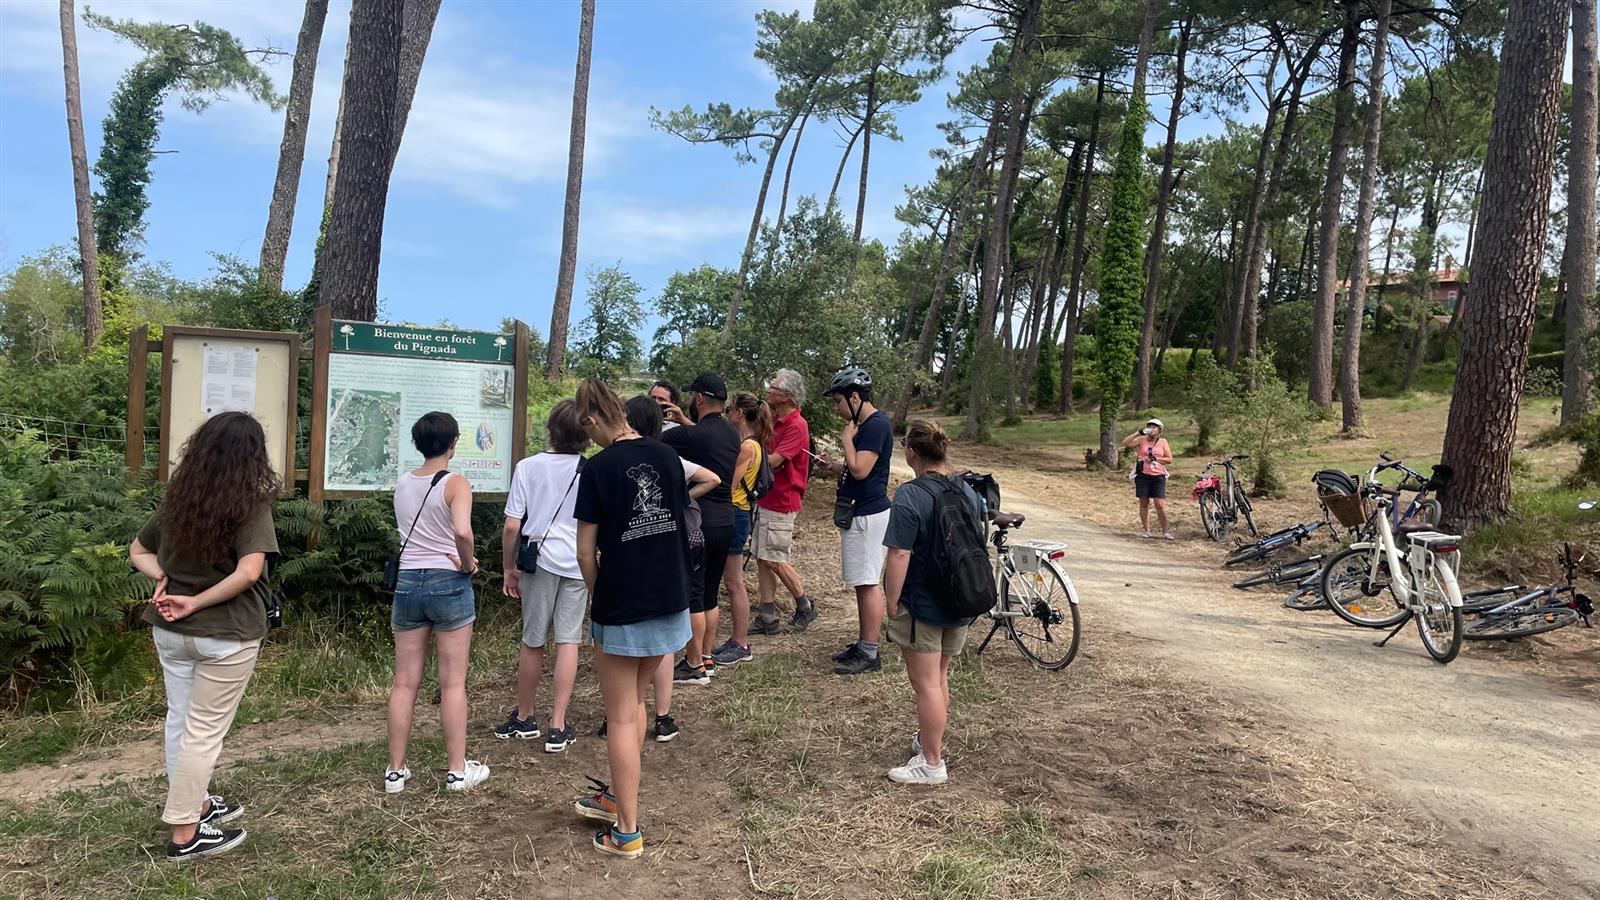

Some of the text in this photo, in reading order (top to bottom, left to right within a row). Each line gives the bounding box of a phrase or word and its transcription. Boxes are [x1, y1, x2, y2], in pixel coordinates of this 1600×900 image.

[374, 328, 432, 341] Bienvenue
[451, 334, 476, 345] forêt
[394, 341, 456, 354] du Pignada
